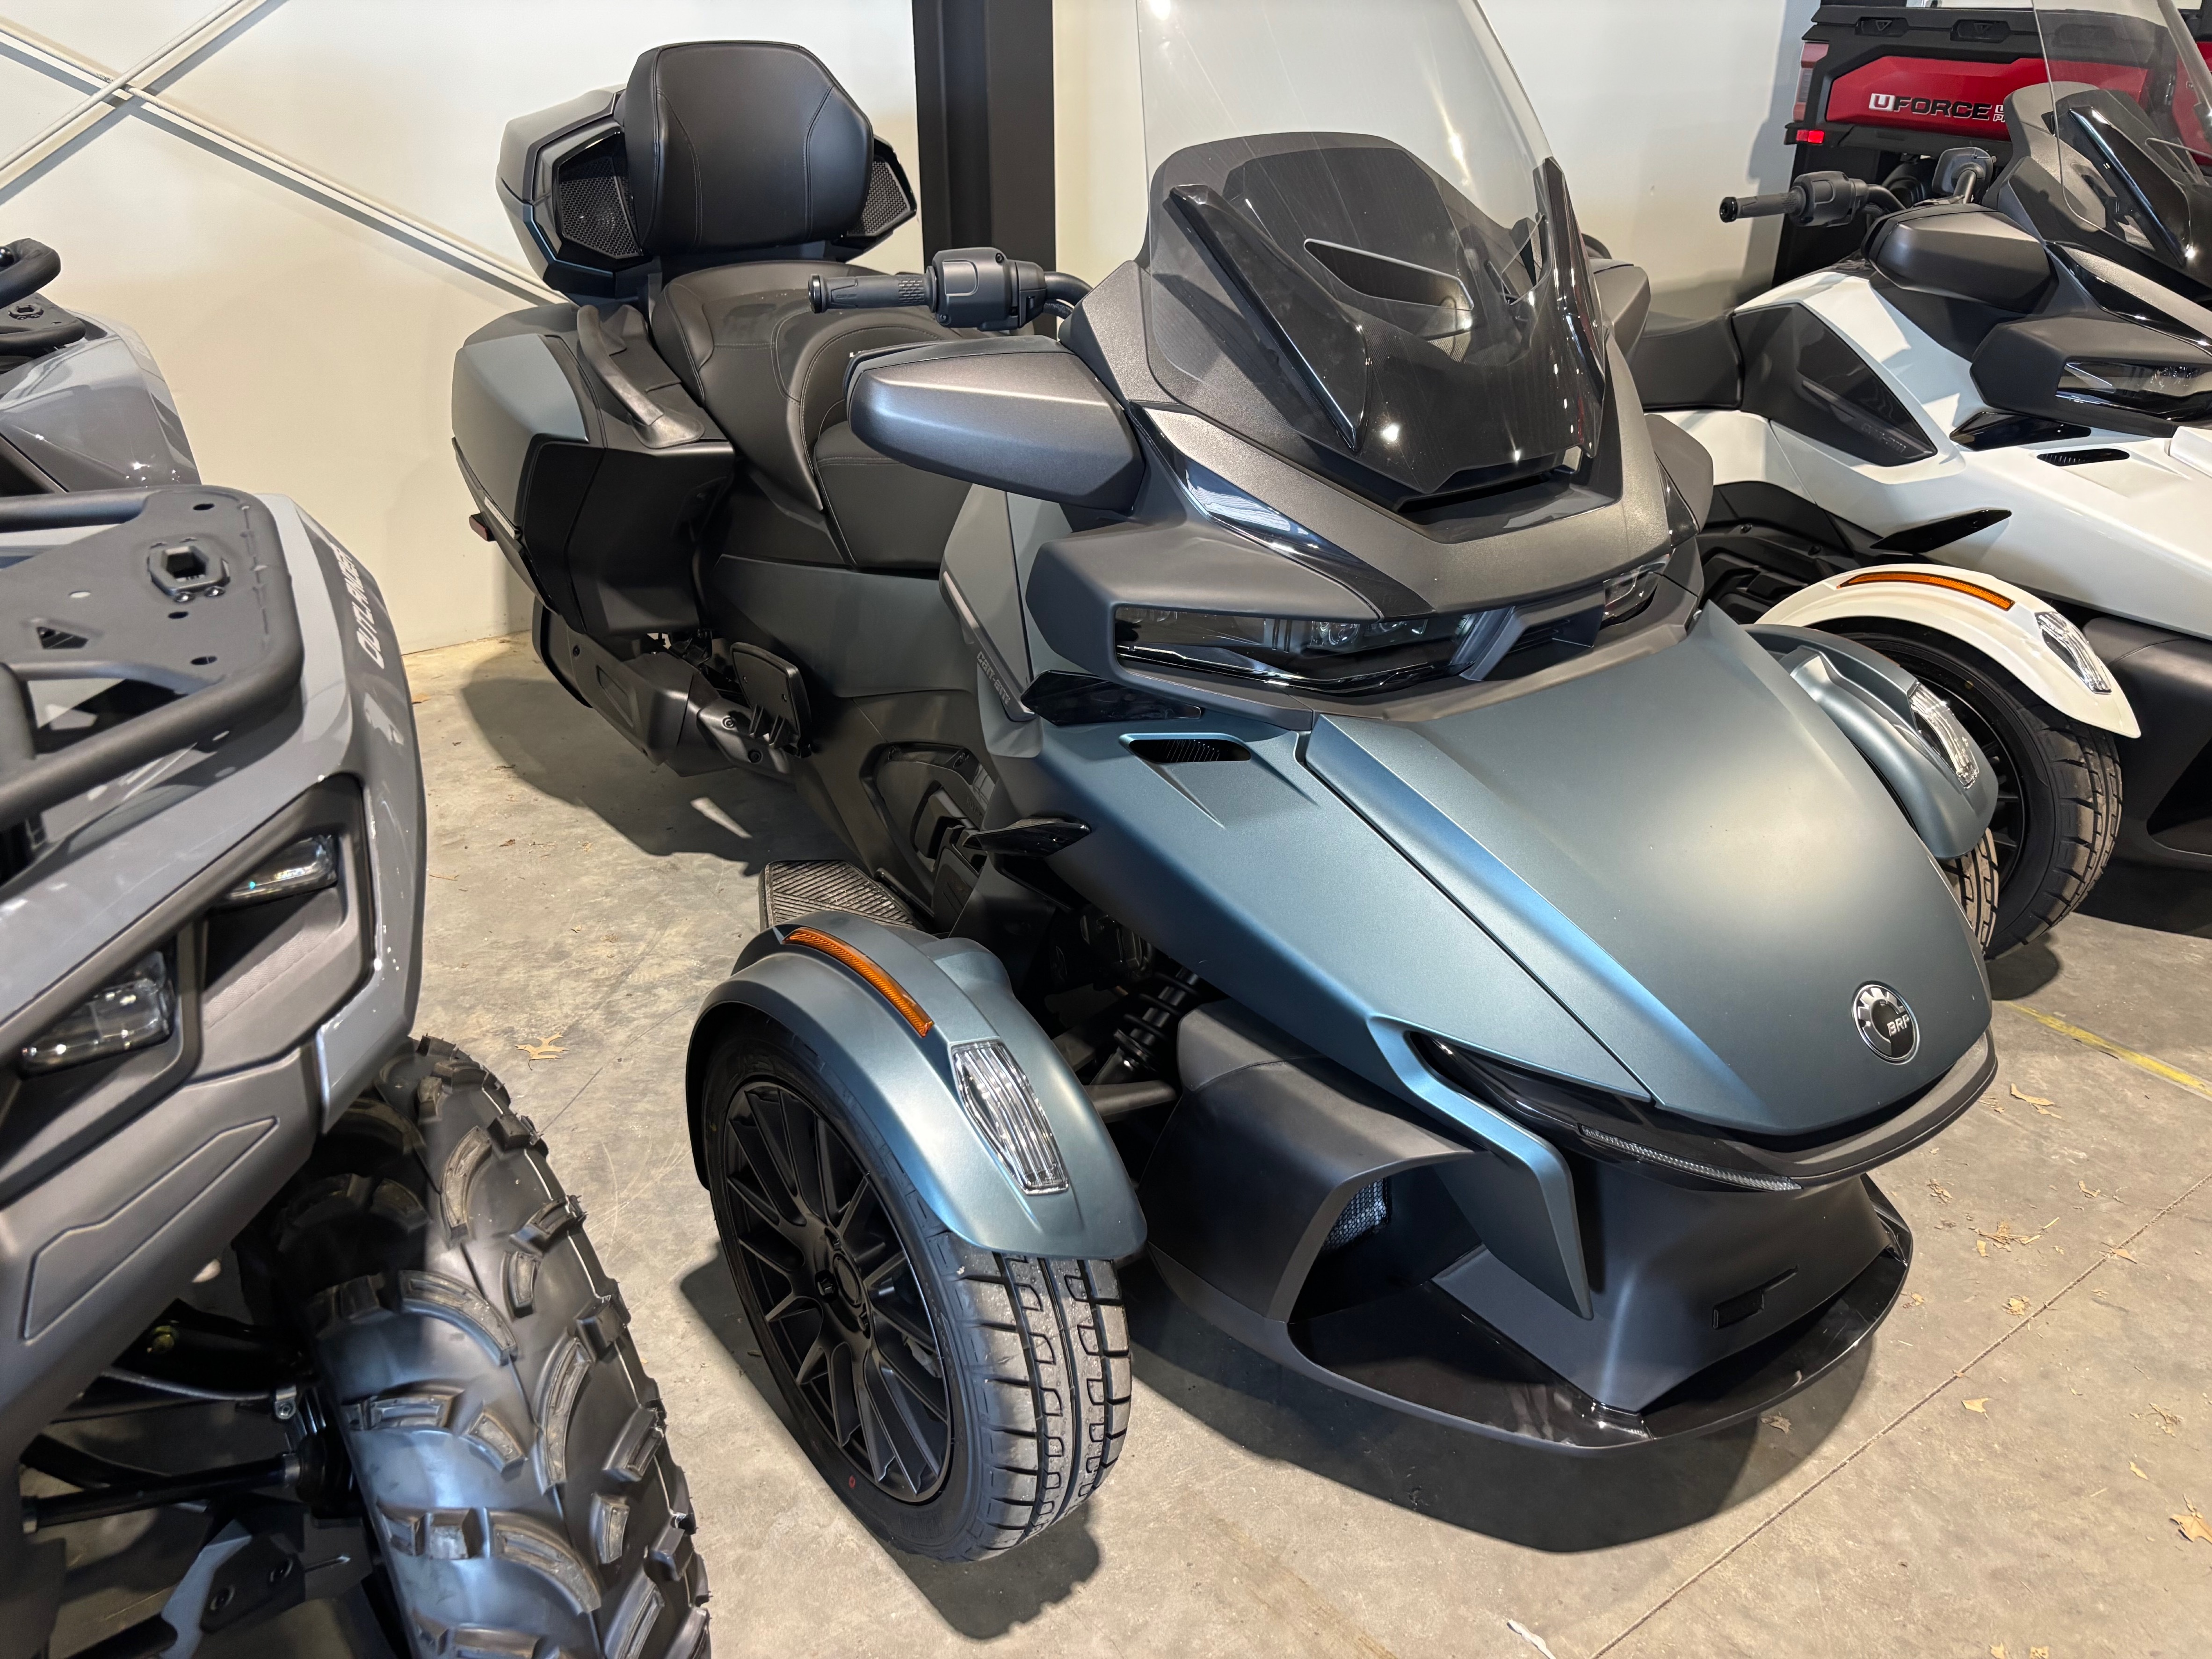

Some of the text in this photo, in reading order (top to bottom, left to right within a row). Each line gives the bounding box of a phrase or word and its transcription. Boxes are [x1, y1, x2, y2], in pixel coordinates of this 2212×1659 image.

[332, 546, 384, 669] OUTLANDER
[977, 651, 1010, 706] can-am
[1887, 1014, 1909, 1037] BRP
